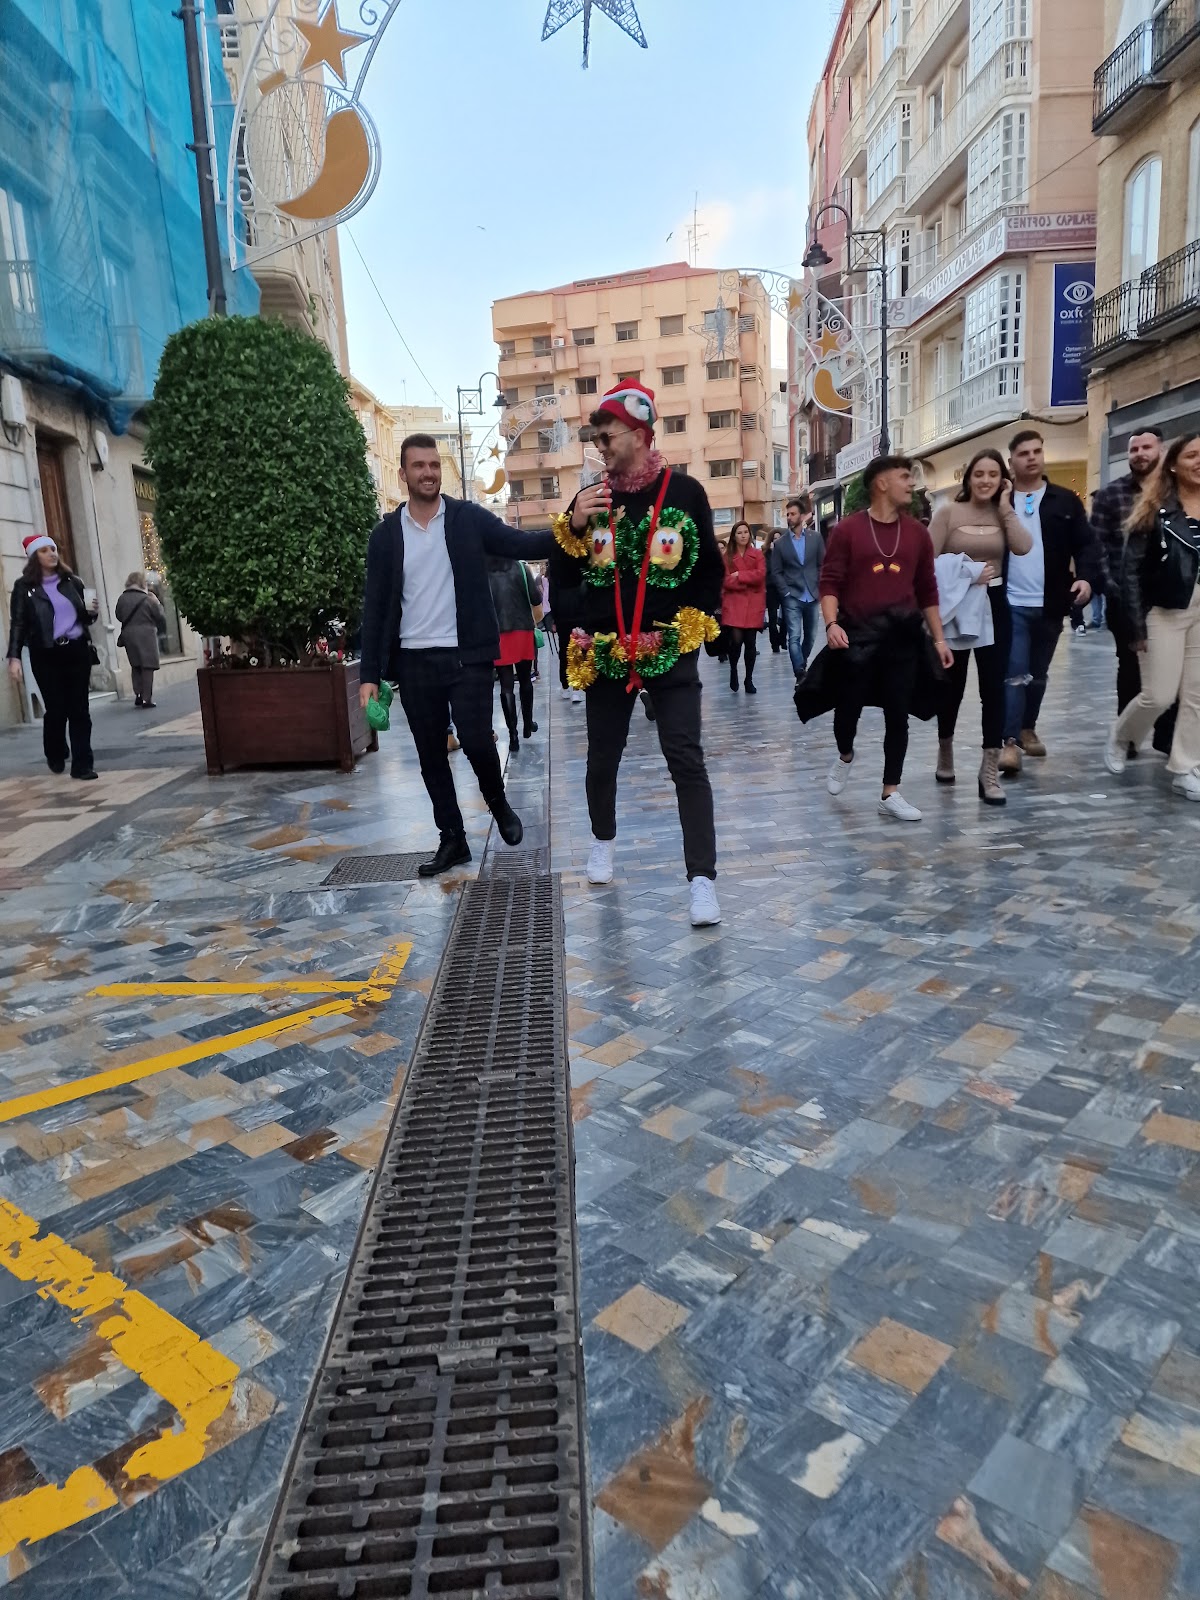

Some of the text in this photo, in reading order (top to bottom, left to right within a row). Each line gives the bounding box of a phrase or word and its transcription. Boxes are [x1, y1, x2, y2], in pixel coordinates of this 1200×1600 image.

[1007, 213, 1097, 229] CENTROS CAPILARE
[924, 264, 952, 299] CENTROS
[954, 236, 986, 275] CAPILARES
